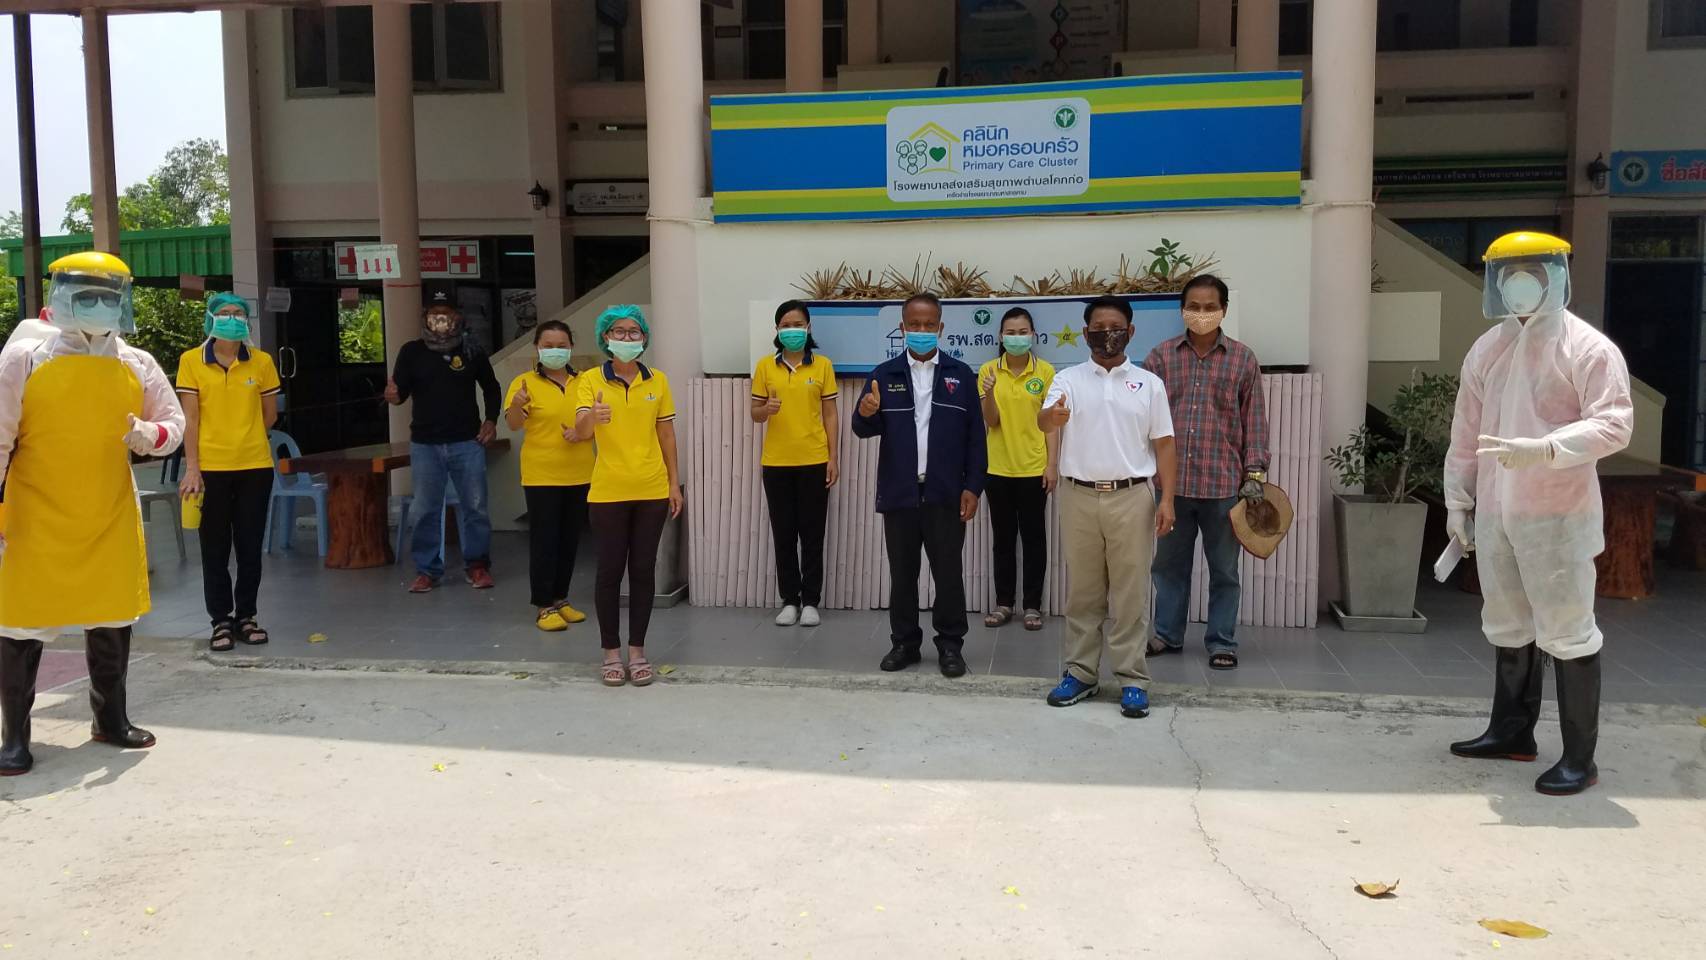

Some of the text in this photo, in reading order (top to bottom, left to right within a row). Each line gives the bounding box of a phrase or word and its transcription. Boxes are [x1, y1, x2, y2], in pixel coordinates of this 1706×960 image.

[963, 125, 1008, 142] คลินิก
[963, 136, 1079, 158] หมอครอบครัว
[963, 157, 1078, 172] Primary Care Cluster
